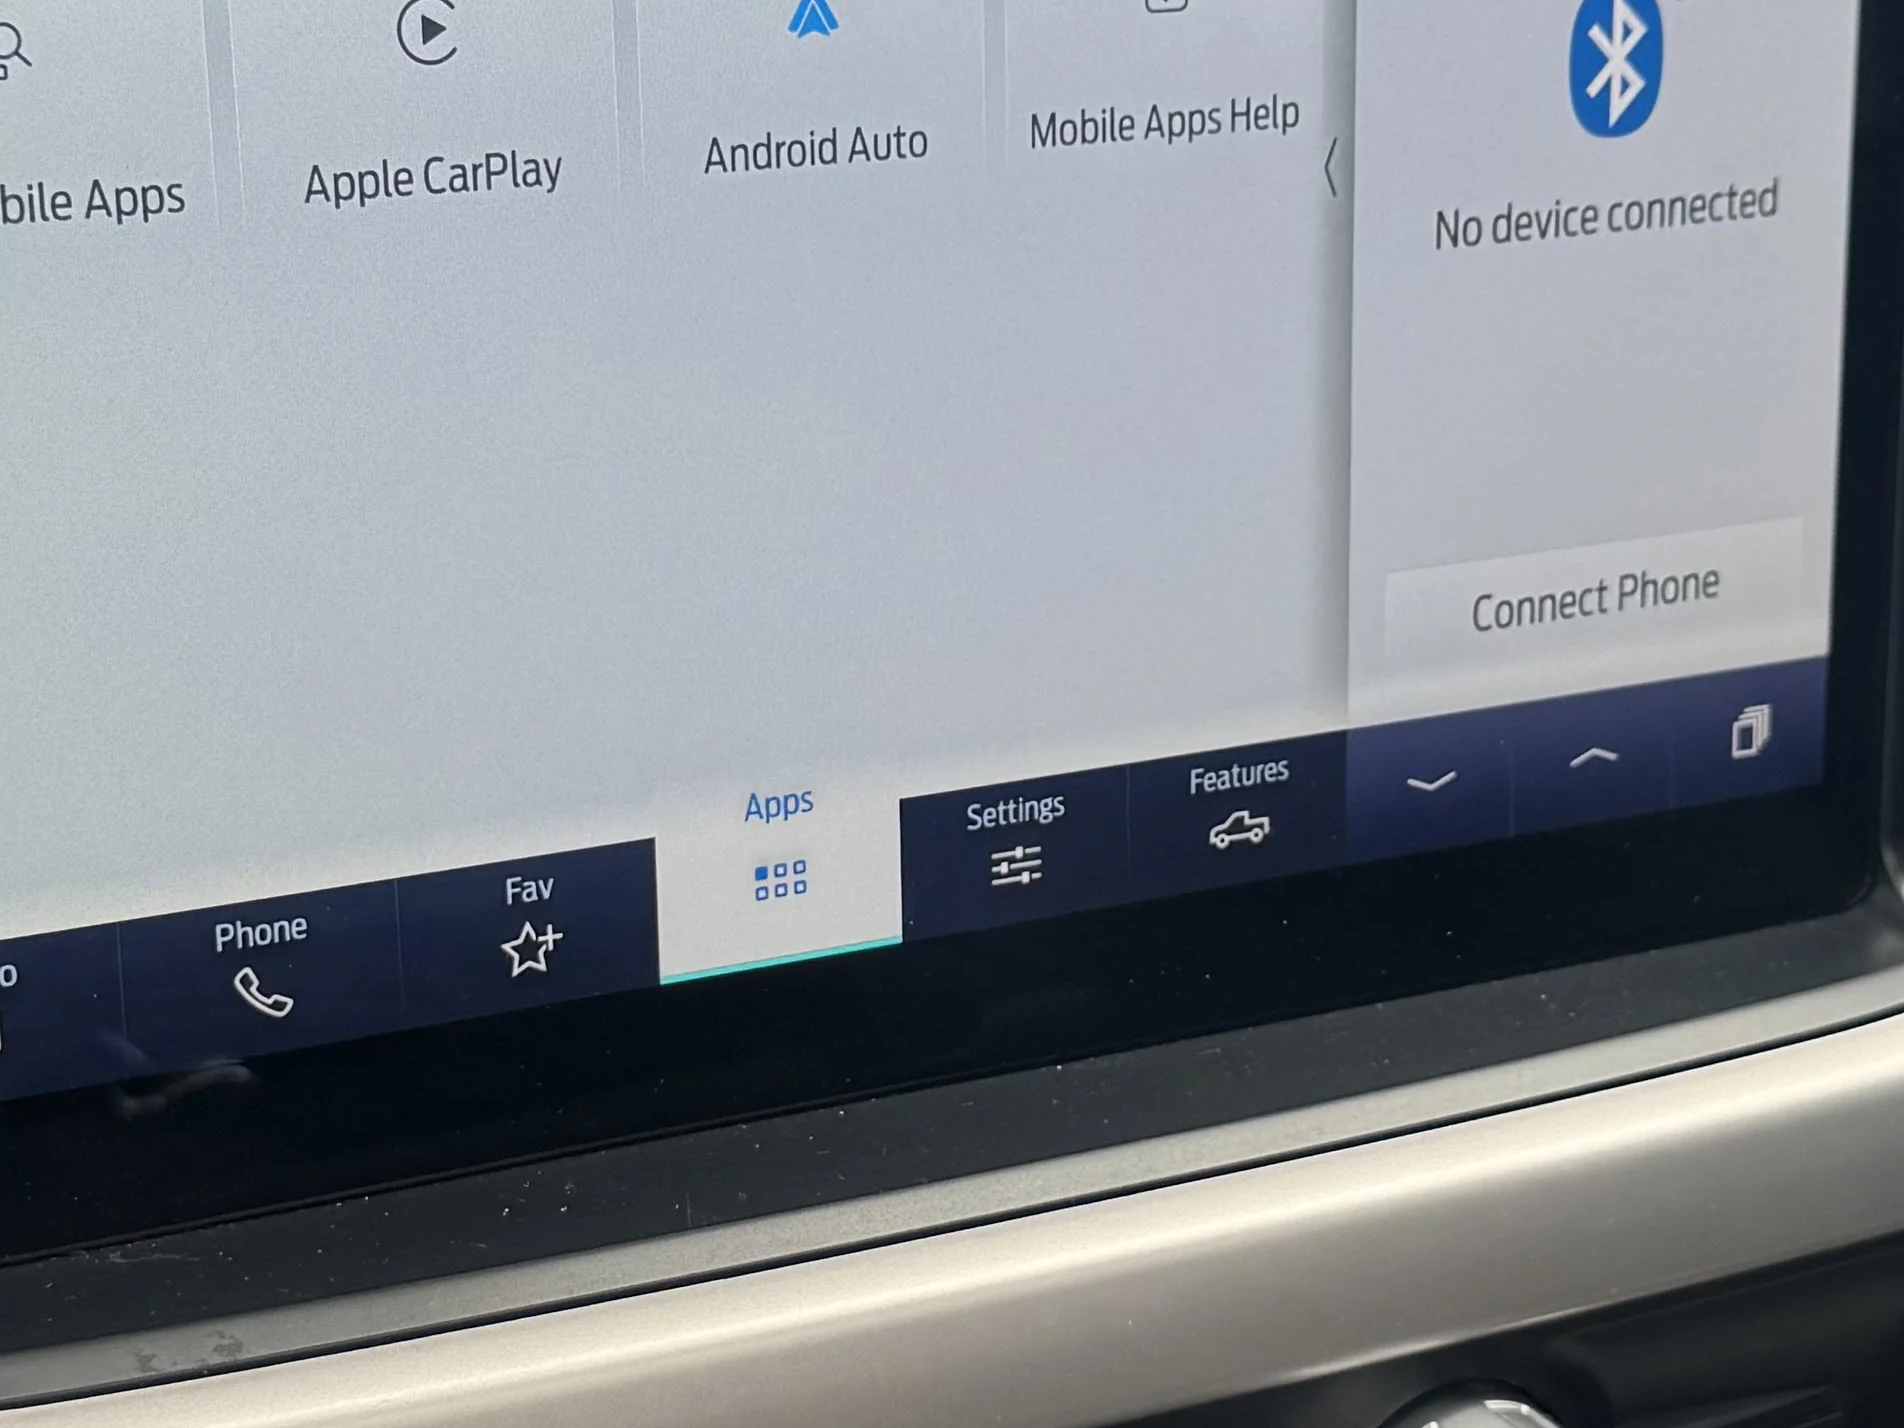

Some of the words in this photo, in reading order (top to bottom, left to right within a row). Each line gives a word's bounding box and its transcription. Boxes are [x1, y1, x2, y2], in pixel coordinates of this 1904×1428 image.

[1031, 106, 1135, 149] Mobile
[1143, 103, 1222, 150] Apps
[1230, 93, 1300, 140] Help
[703, 126, 838, 175] Android
[847, 124, 928, 165] Auto
[84, 178, 186, 228] Apps
[304, 158, 414, 210] Apple
[423, 149, 563, 199] CarPlay
[1435, 208, 1483, 251] No
[1491, 199, 1599, 245] device
[1607, 177, 1779, 234] connected
[1472, 579, 1609, 633] Connect
[1617, 569, 1721, 612] Phone
[1189, 759, 1290, 795] Features
[744, 790, 814, 826] Apps
[966, 793, 1065, 832] Settings
[506, 876, 554, 906] Fav
[214, 913, 308, 953] Phone
